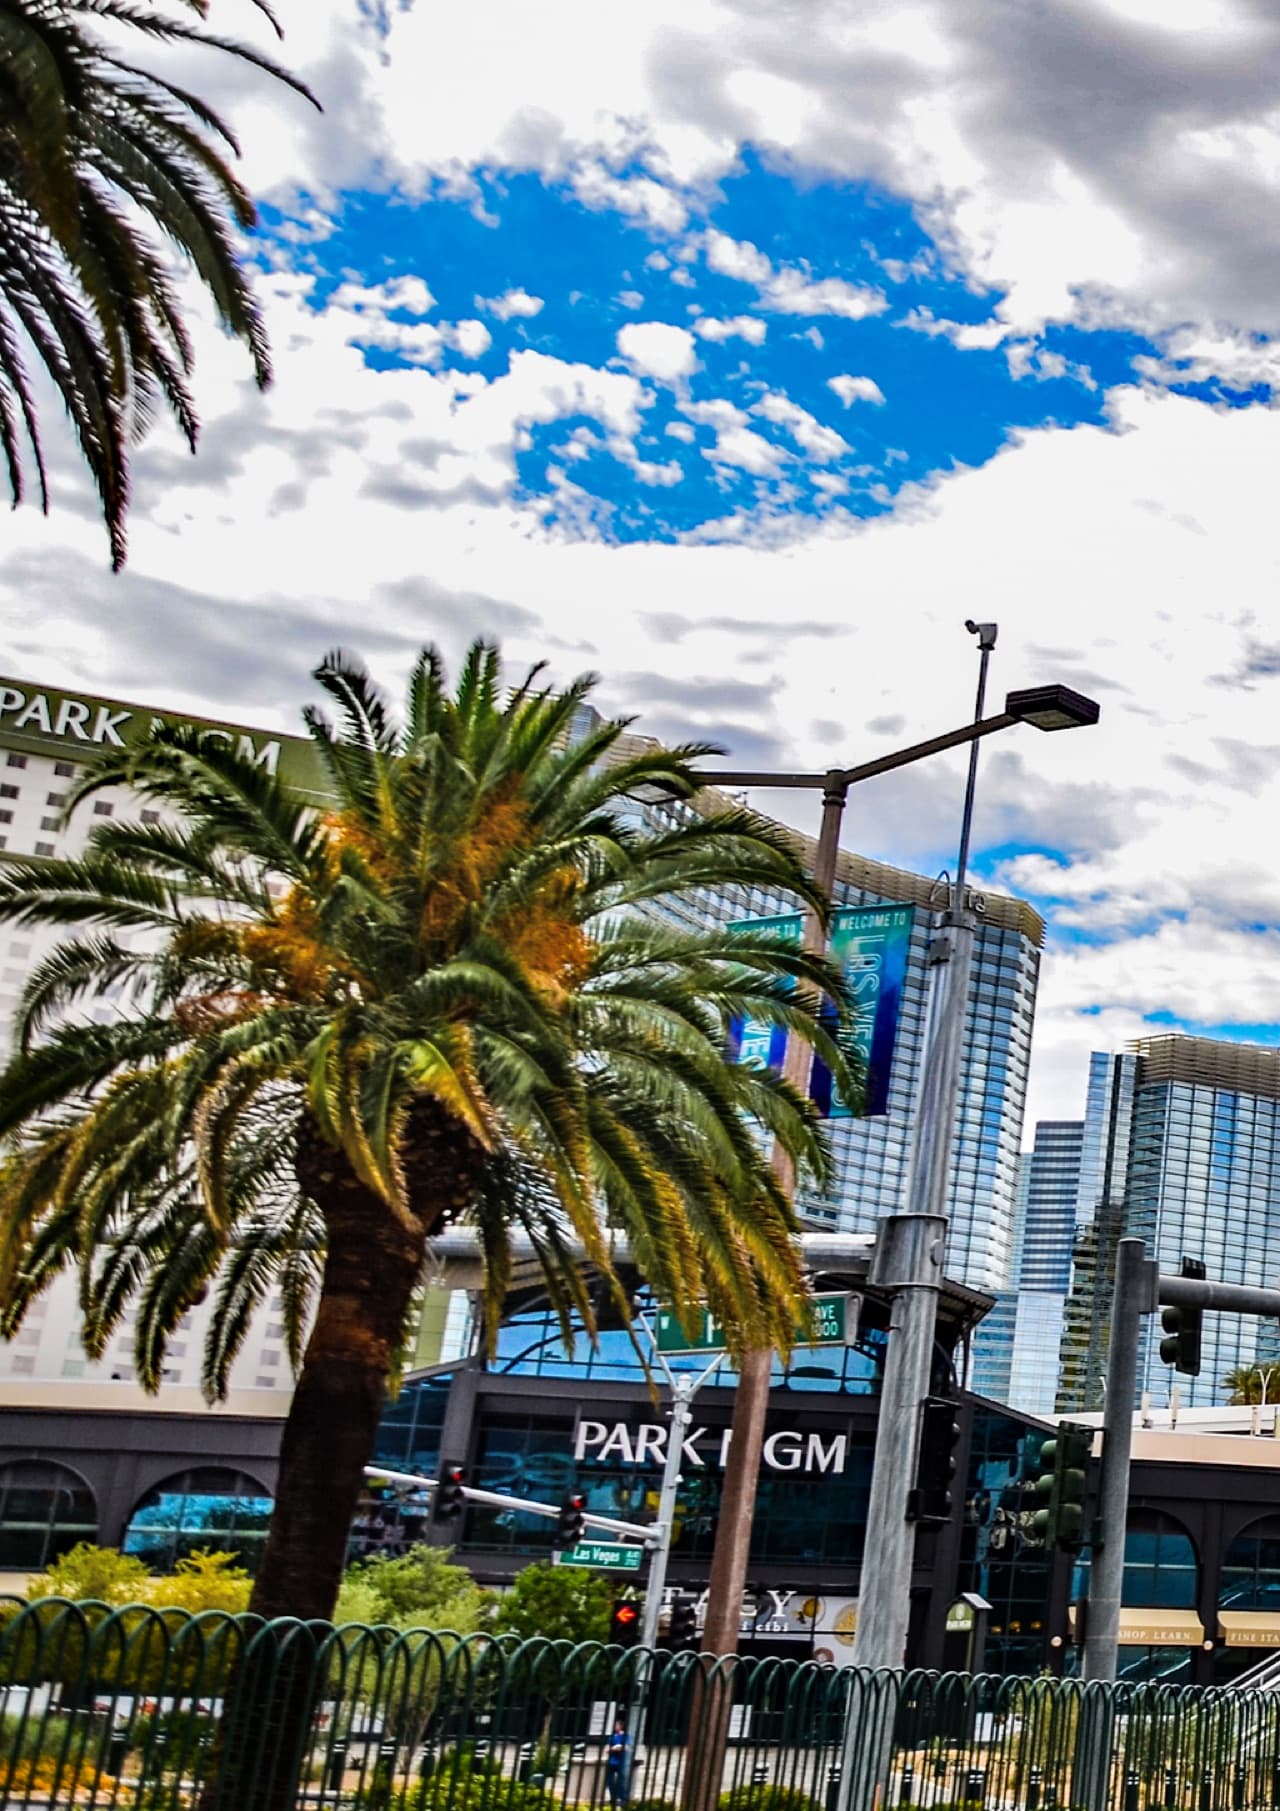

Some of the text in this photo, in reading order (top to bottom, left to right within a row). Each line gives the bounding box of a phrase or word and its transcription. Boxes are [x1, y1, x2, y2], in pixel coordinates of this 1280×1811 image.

[0, 686, 133, 747] PARK
[839, 912, 906, 930] WELCOME TO
[845, 934, 885, 995] LAS
[814, 1305, 836, 1320] AVE
[574, 1421, 708, 1466] PARK
[573, 1545, 590, 1560] Las
[593, 1546, 620, 1565] Vegas
